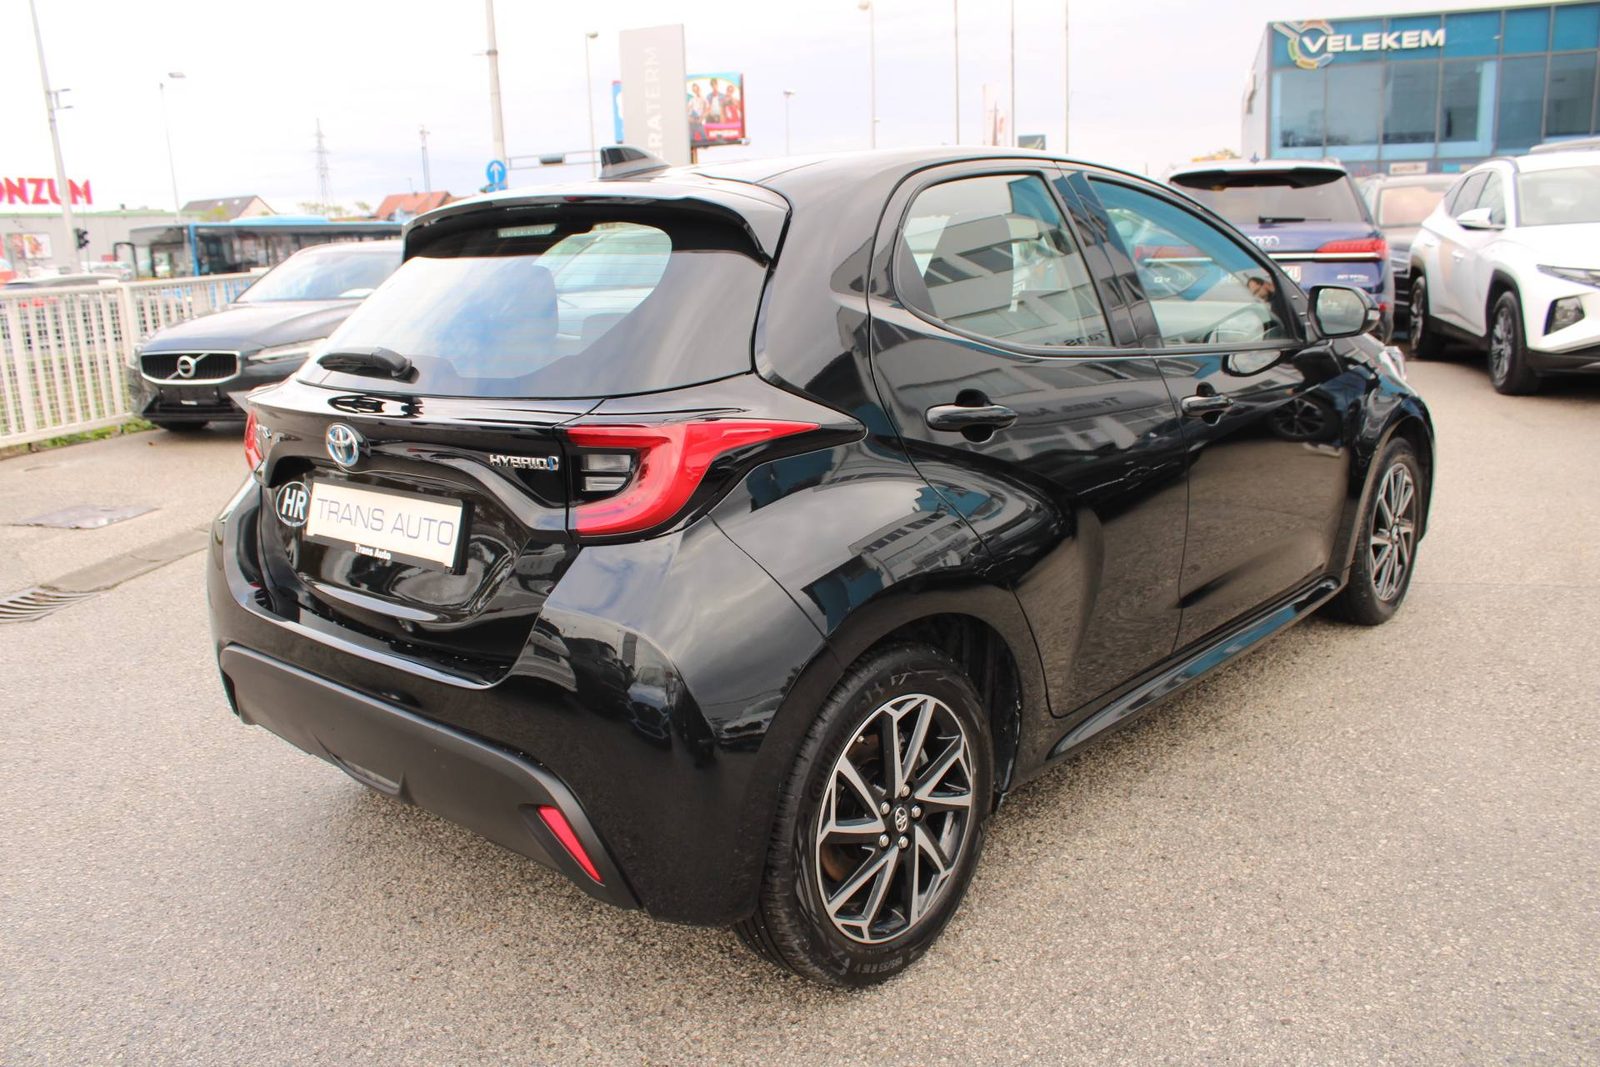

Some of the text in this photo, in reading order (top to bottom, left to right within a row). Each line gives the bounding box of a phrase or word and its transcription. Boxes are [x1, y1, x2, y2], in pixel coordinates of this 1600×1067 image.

[1301, 28, 1447, 53] VELEKEM
[489, 454, 547, 470] HYBRID
[282, 487, 307, 520] HR
[317, 498, 454, 546] TRANS AUTO
[355, 543, 392, 560] Trans Auto
